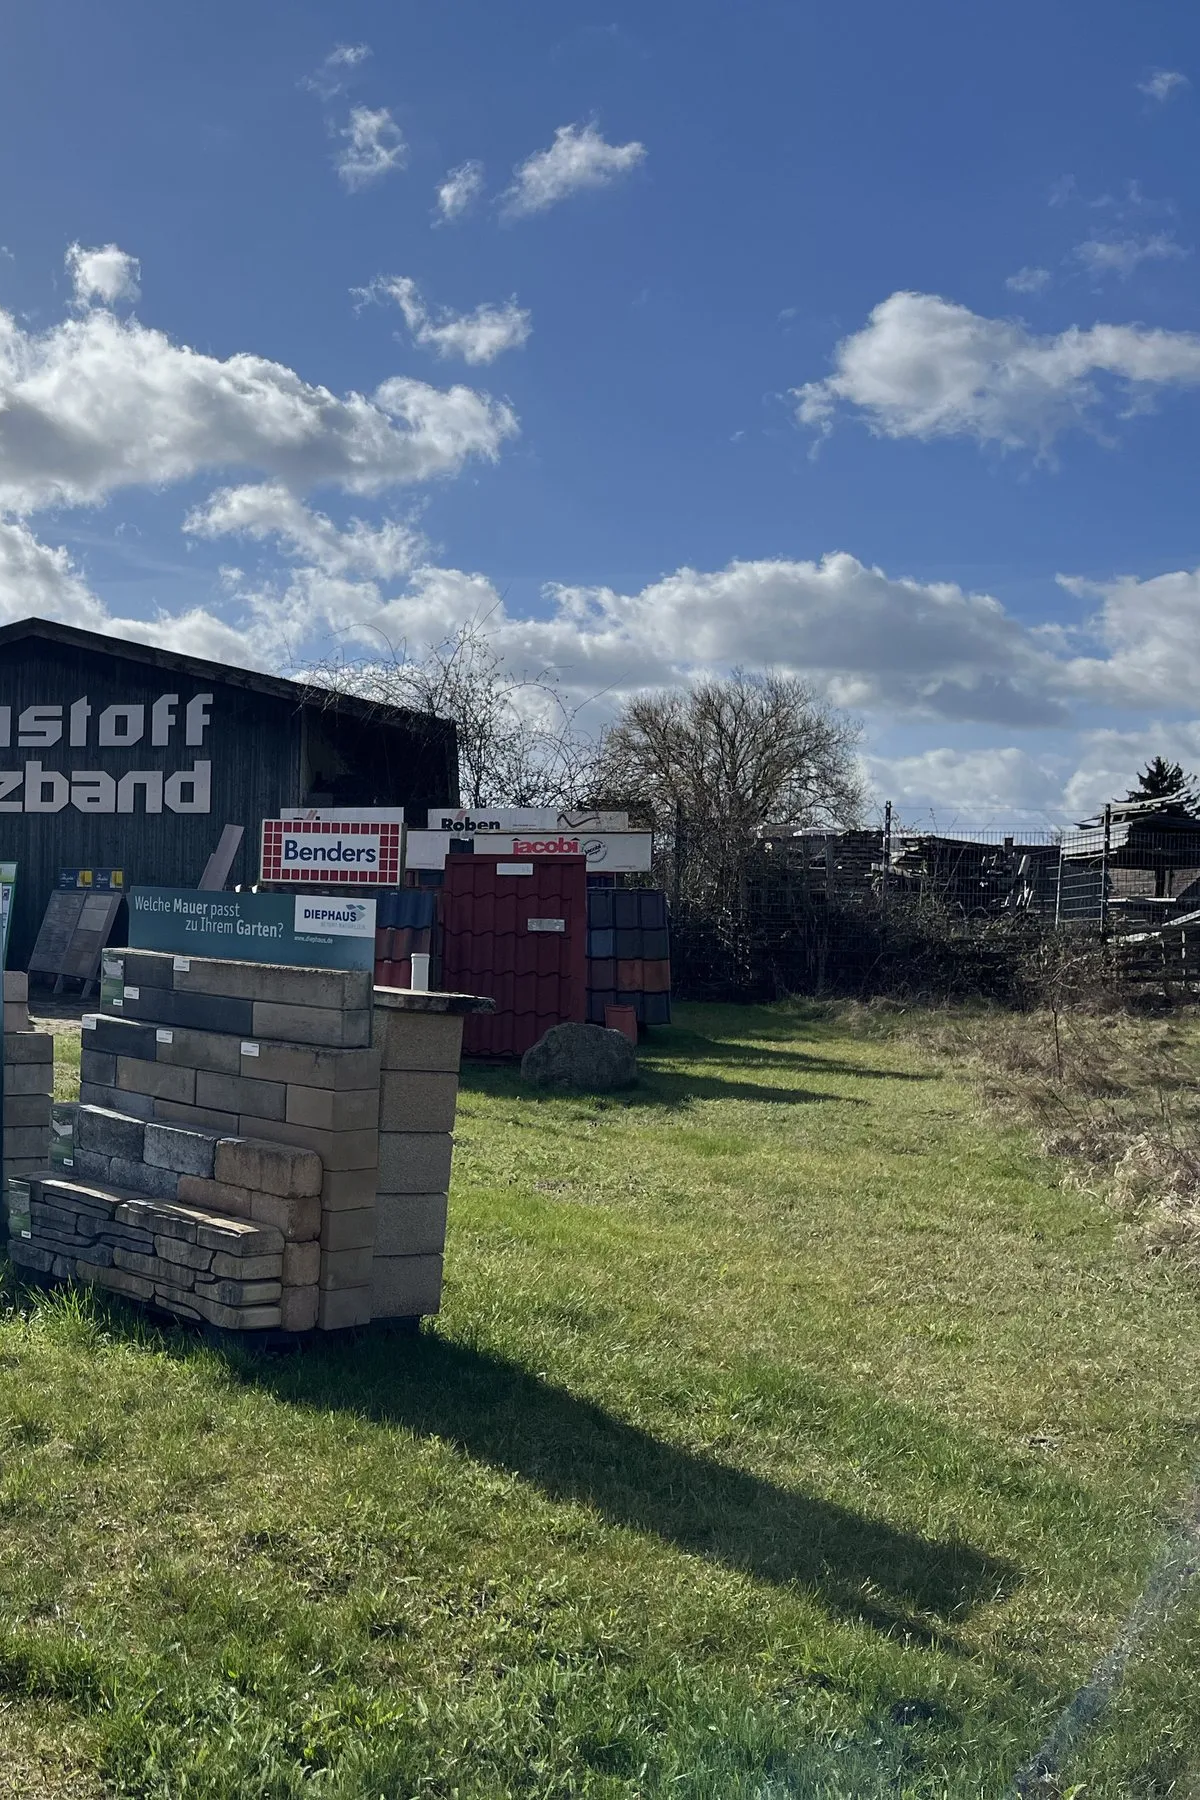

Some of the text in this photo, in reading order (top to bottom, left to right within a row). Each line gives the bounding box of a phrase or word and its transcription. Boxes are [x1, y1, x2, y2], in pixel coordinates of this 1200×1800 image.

[284, 839, 377, 863] Benders
[512, 837, 580, 856] jacobi
[134, 896, 241, 919] Welche Mauer passt
[303, 909, 357, 922] DIEPHAUS
[185, 917, 284, 938] zu Ihrem Garten?
